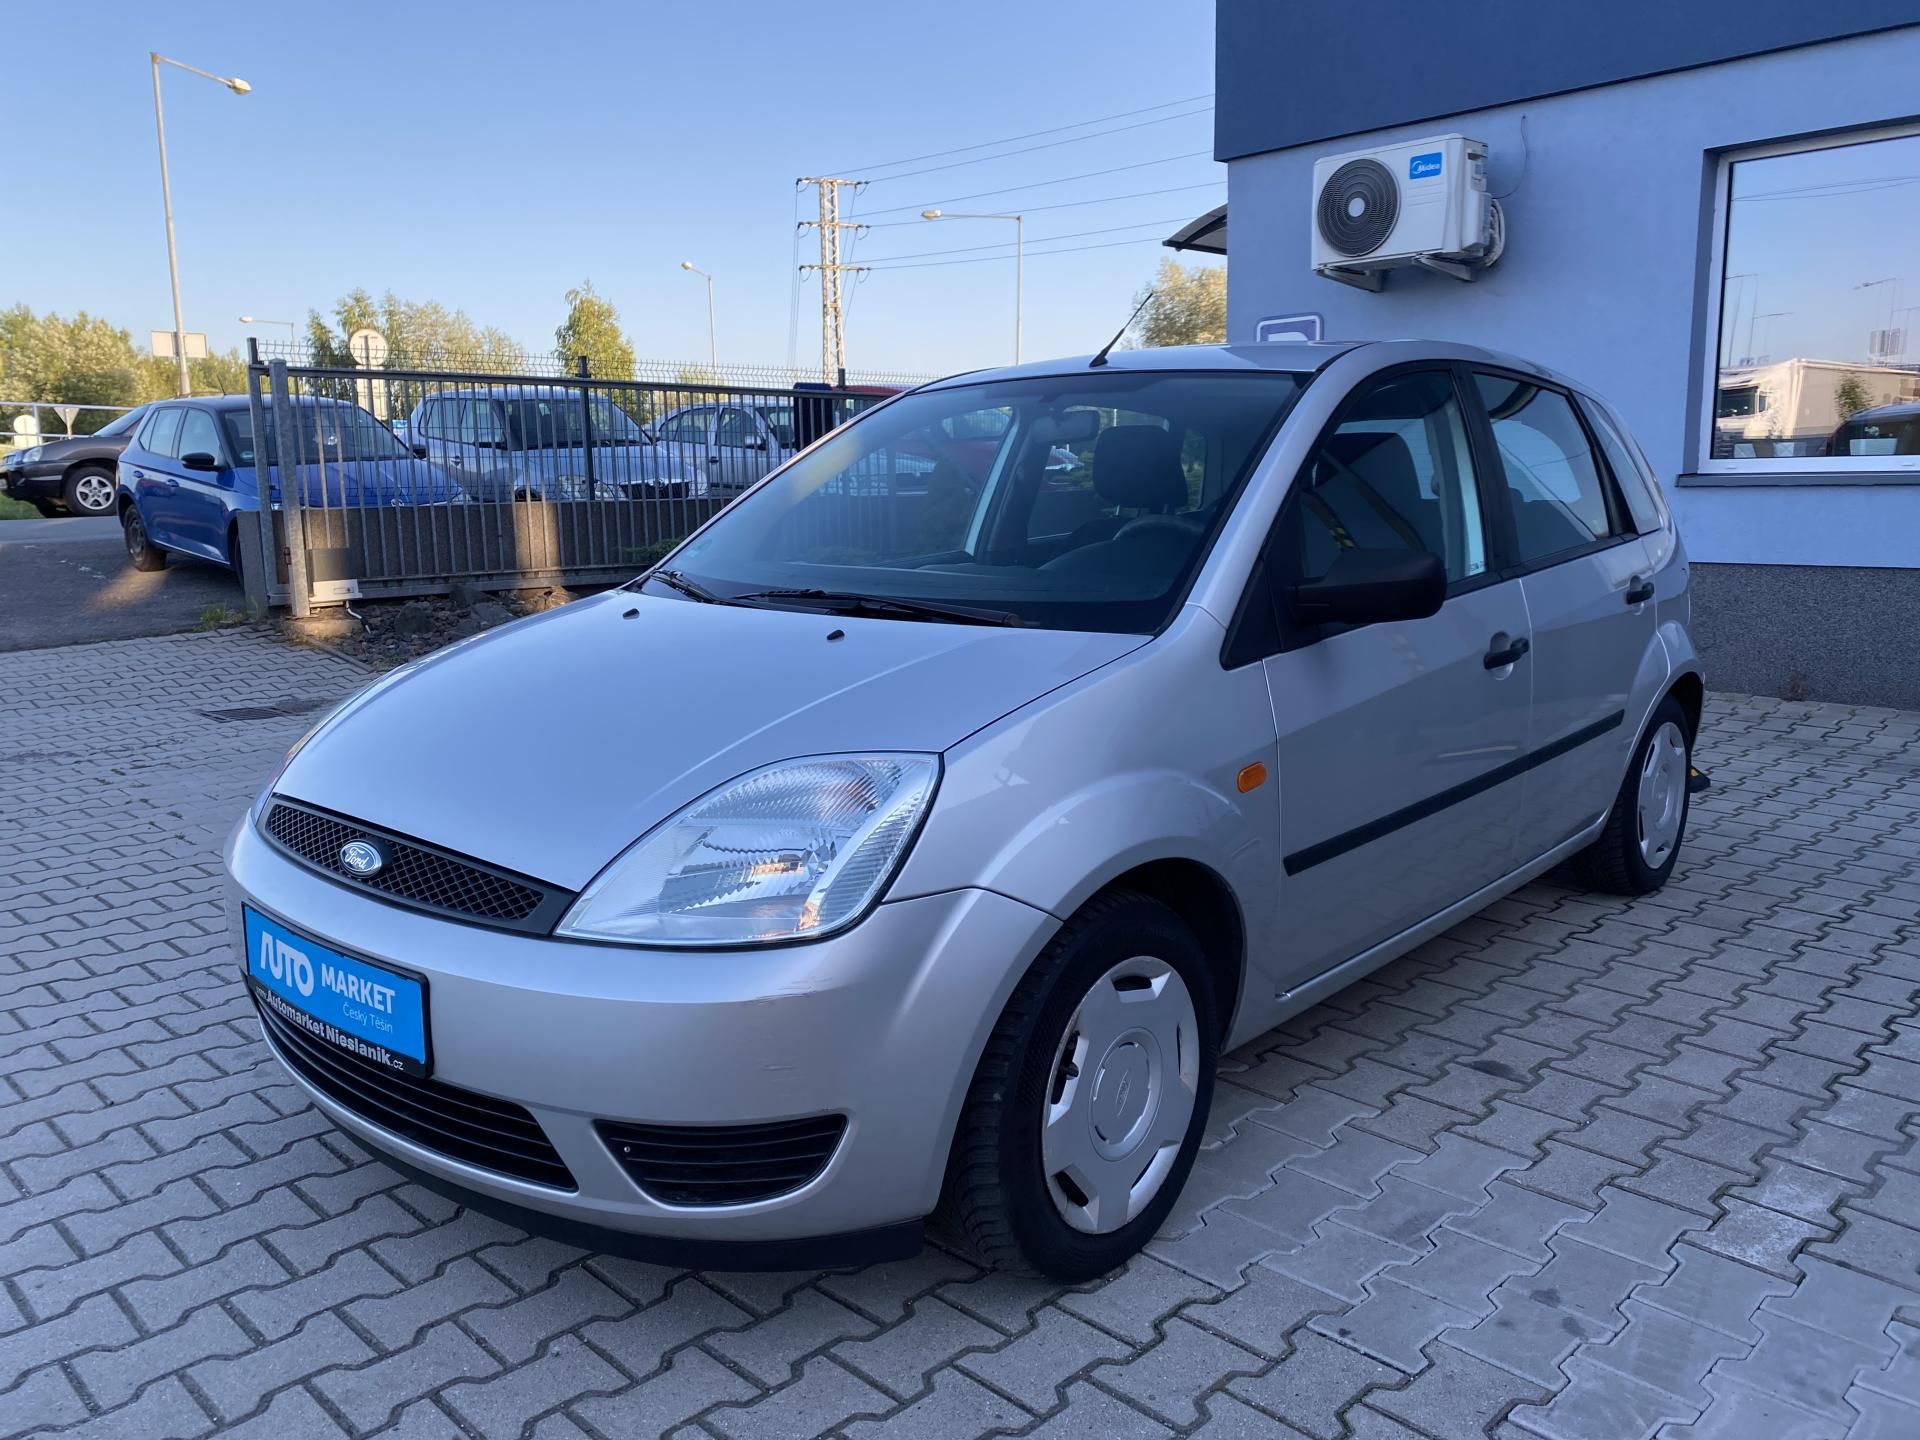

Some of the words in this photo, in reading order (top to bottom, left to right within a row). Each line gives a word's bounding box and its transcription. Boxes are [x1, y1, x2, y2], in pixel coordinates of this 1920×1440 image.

[345, 847, 370, 870] Ford
[260, 930, 315, 997] AUTO
[321, 963, 396, 1014] MARKET
